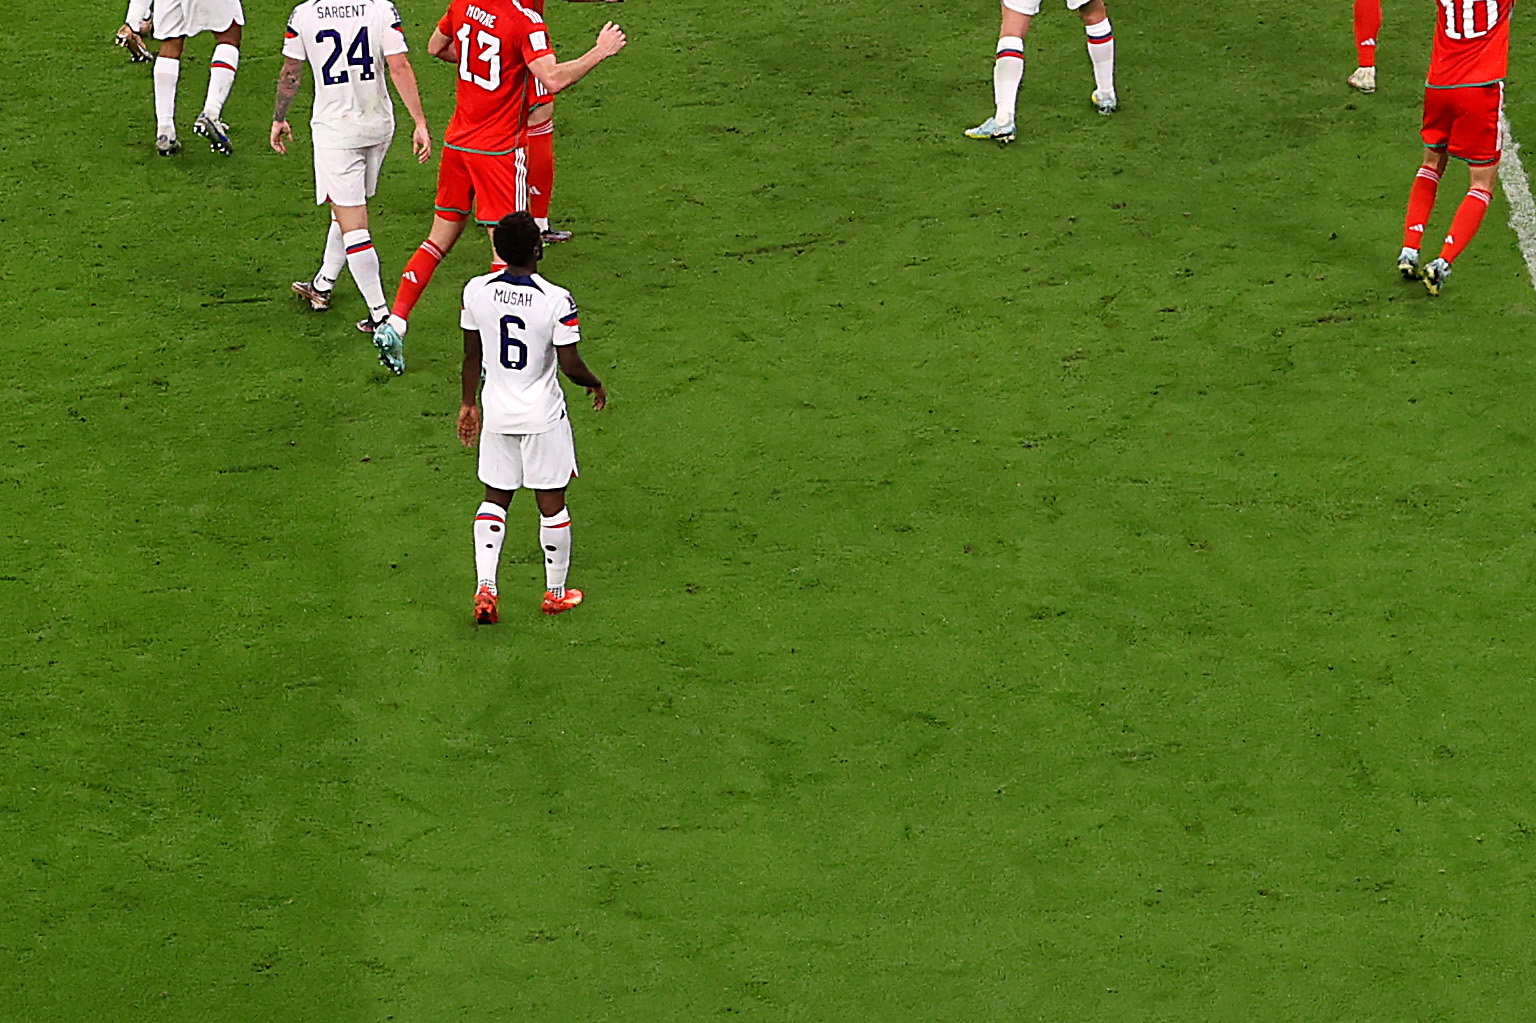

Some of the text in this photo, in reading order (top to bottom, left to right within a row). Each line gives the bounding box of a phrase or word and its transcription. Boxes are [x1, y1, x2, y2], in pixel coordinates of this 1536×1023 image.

[316, 3, 367, 19] SARGENT
[315, 25, 375, 86] 24
[455, 23, 502, 92] 13
[493, 288, 533, 308] MUSAH
[499, 314, 528, 371] 6
